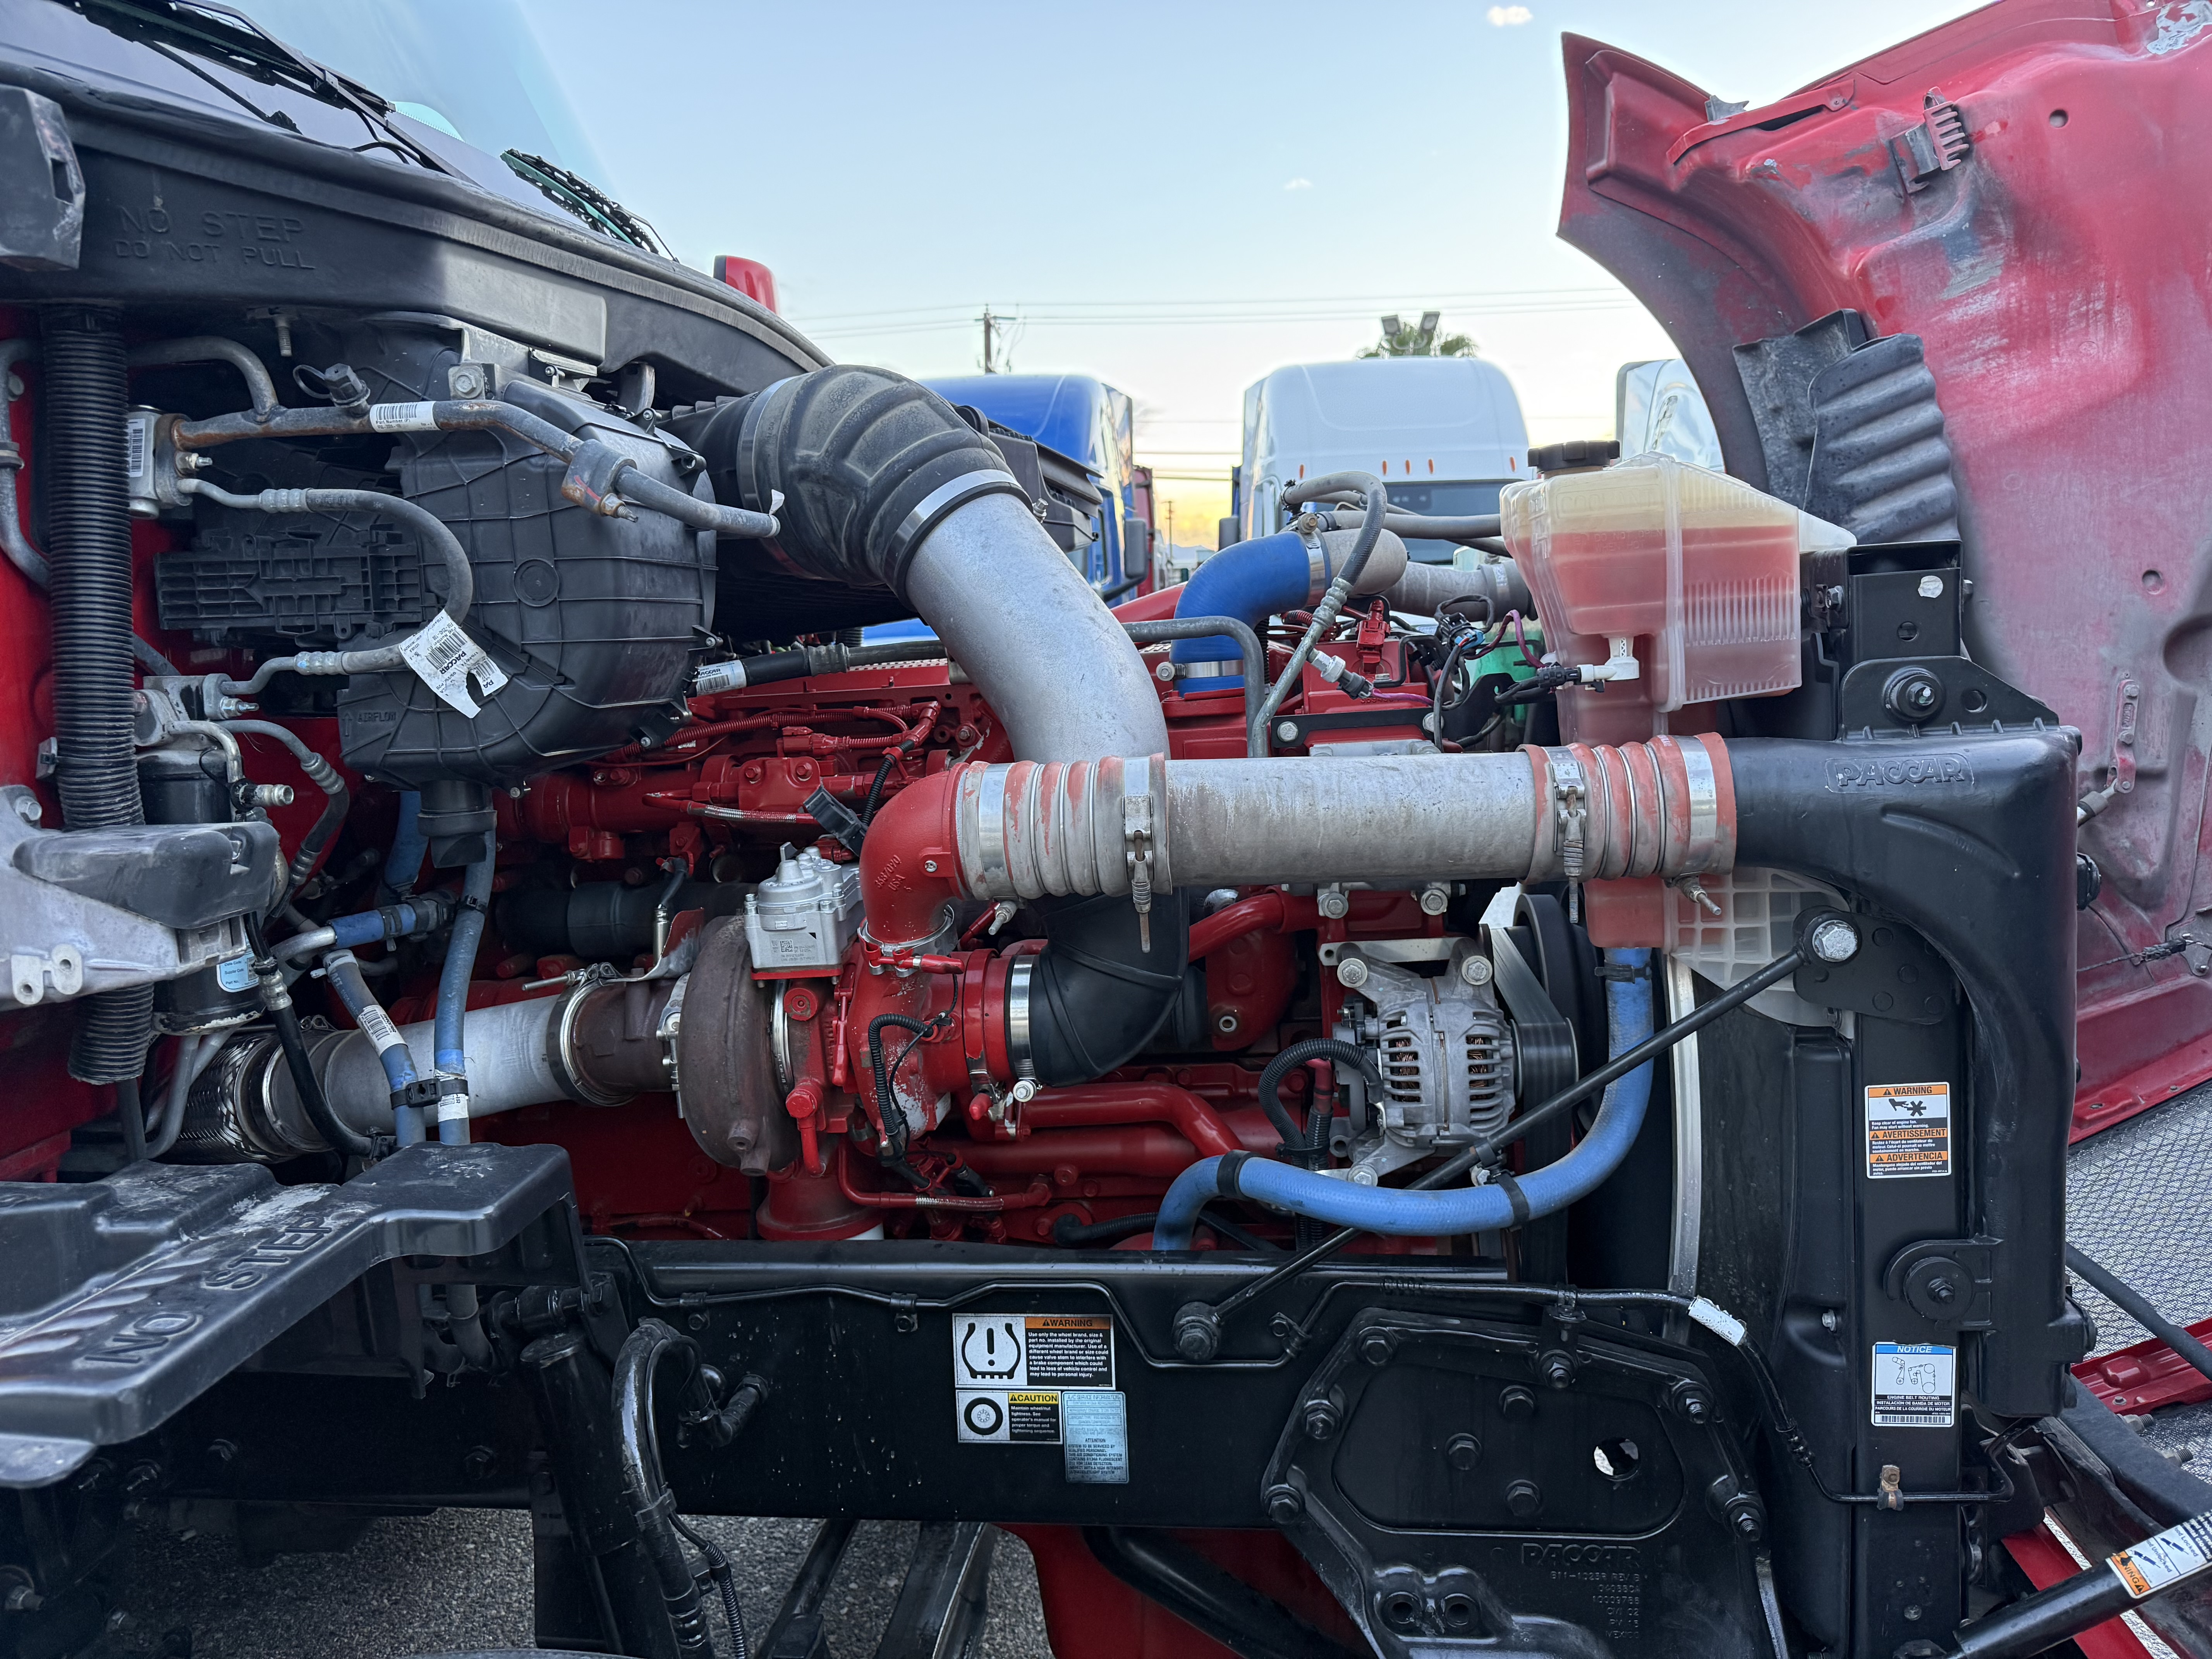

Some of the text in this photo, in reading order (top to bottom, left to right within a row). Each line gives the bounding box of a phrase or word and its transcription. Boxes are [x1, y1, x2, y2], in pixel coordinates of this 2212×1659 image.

[120, 205, 304, 243] NO STEP
[117, 240, 316, 270] DO NOT PULL
[1561, 491, 1657, 514] COOLANT
[439, 650, 467, 675] PACCAR
[358, 712, 397, 722] AIRFLOW
[1835, 757, 1965, 787] PACCAR
[888, 875, 905, 890] USA
[1894, 1086, 1932, 1095] WARNING
[1882, 1129, 1946, 1138] AVERTISSEMENT
[1887, 1152, 1942, 1161] ADVERTENCIA
[84, 1214, 333, 1364] NO STEP
[2181, 1536, 2199, 1557] Locked
[2152, 1545, 2172, 1572] Unlocked
